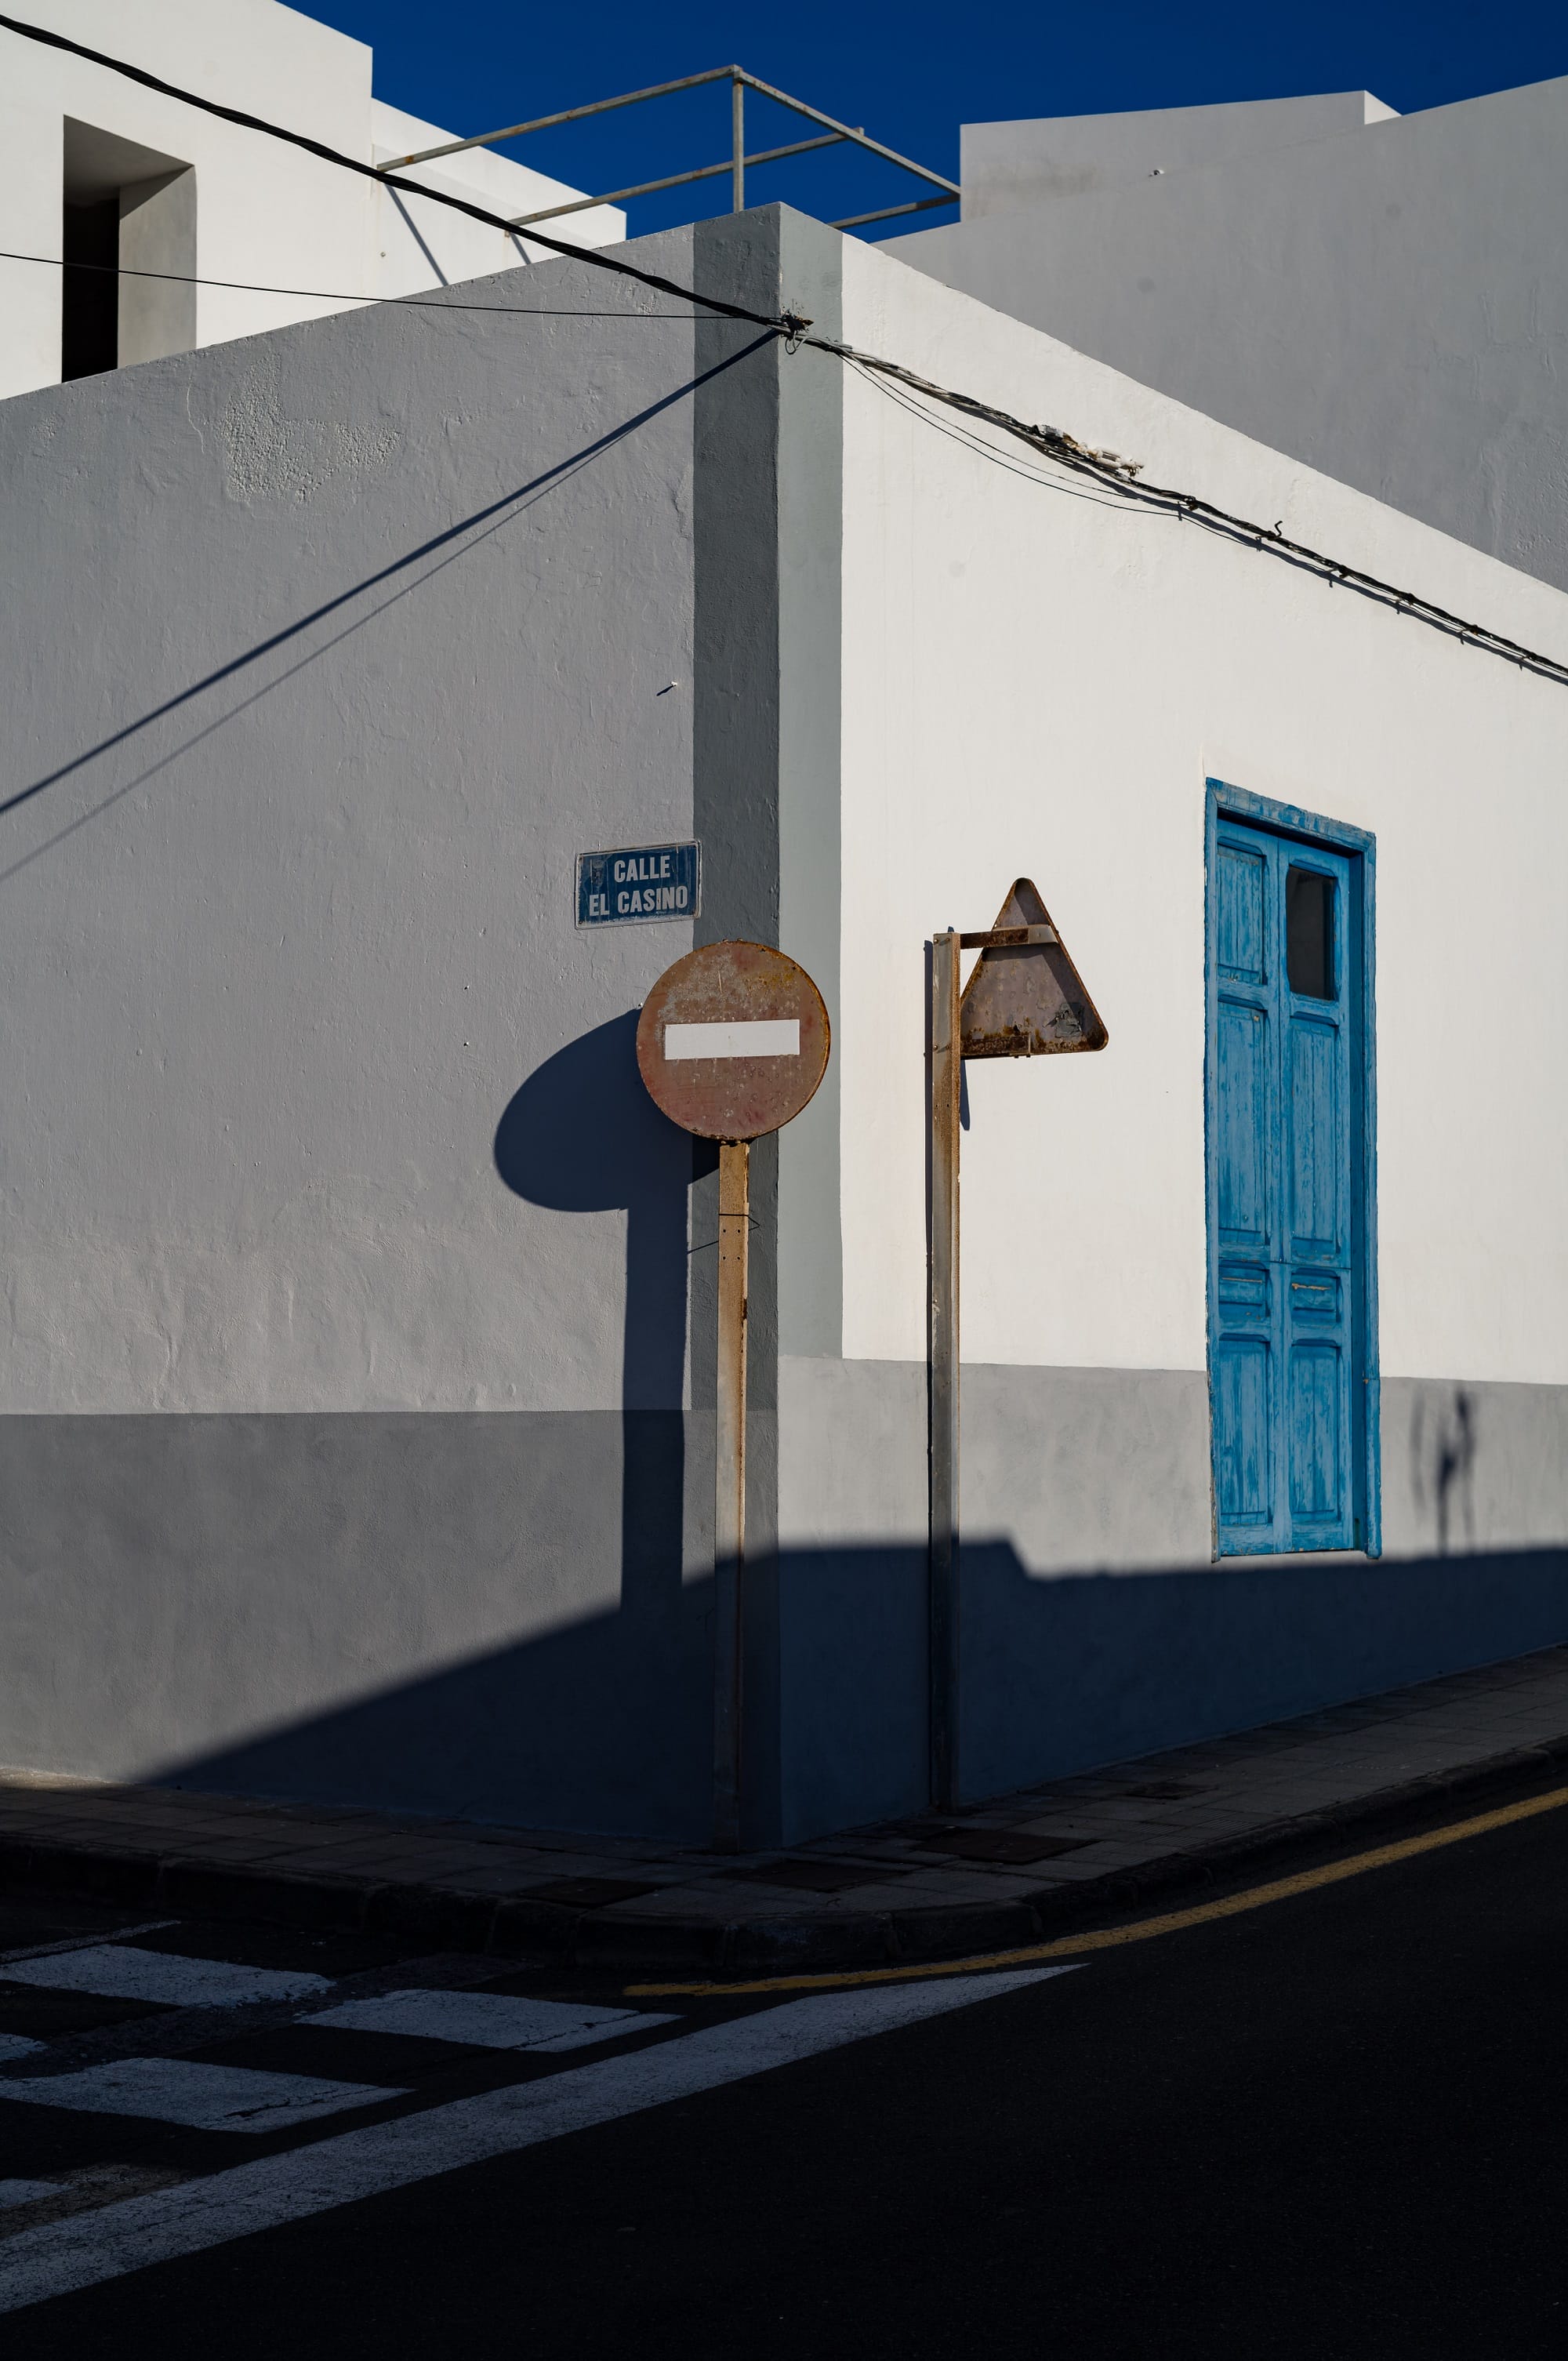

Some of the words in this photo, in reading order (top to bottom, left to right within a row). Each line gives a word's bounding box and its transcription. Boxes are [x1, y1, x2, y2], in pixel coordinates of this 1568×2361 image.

[614, 855, 670, 882] CALLE
[590, 893, 610, 916] EL
[618, 886, 688, 914] CASINO
